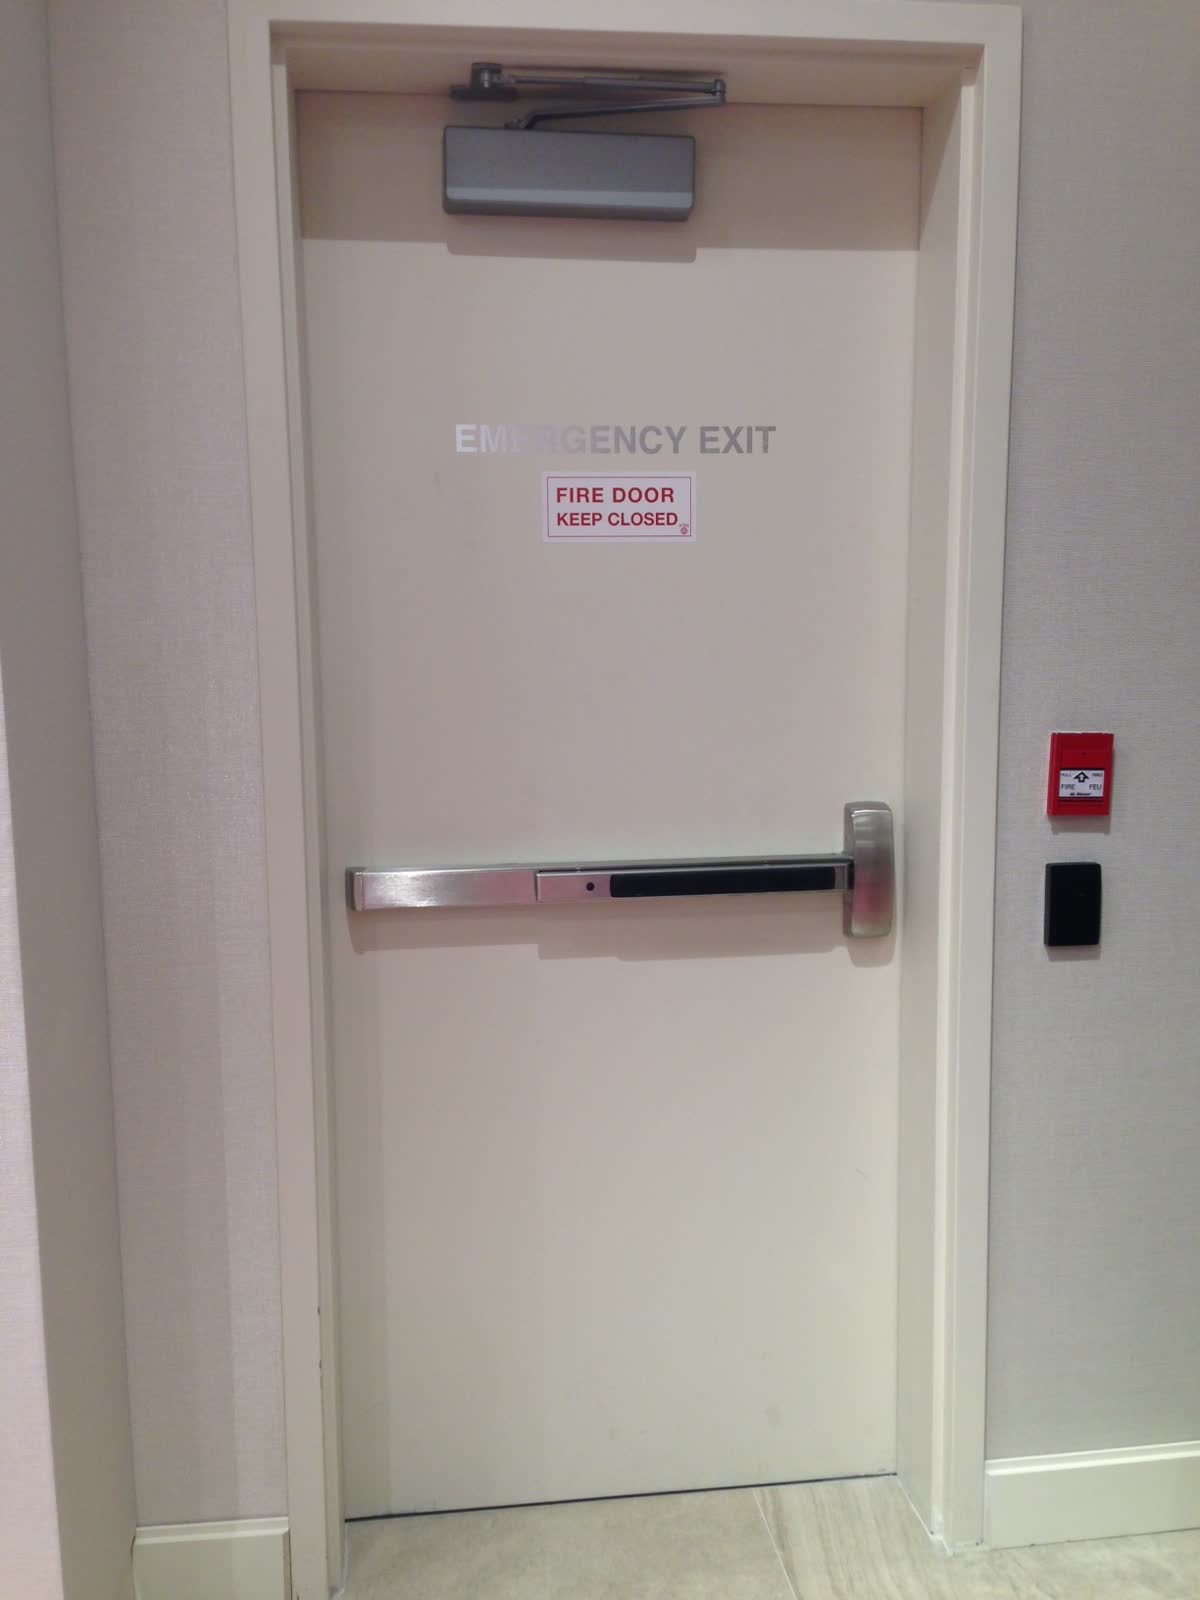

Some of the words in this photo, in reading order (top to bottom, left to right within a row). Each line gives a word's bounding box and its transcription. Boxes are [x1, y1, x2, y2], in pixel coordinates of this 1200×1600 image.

[699, 425, 777, 454] EXIT
[556, 487, 604, 503] FIRE
[612, 487, 675, 503] DOOR
[556, 512, 603, 527] KEEP
[607, 512, 678, 527] CLOSED
